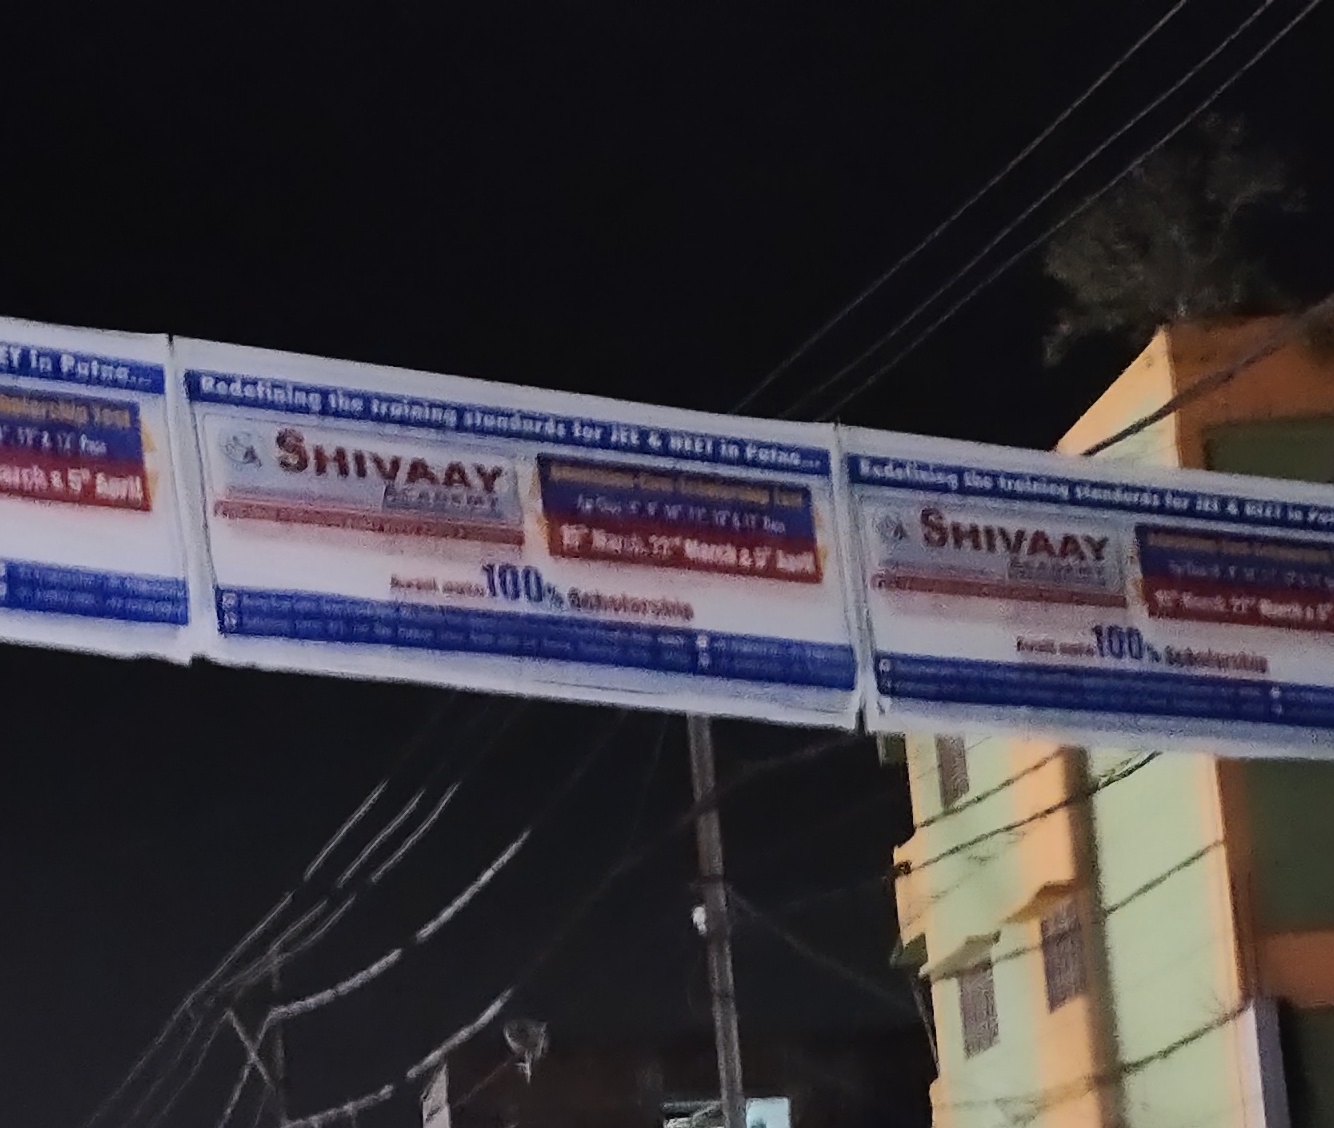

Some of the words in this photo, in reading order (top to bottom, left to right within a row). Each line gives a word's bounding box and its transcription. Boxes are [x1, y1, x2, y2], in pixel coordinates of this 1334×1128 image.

[198, 374, 323, 413] Redefining
[328, 391, 365, 412] the
[370, 398, 458, 428] training
[461, 410, 566, 438] standards
[571, 419, 604, 442] for
[860, 458, 959, 490] Redefining
[963, 471, 994, 489] the
